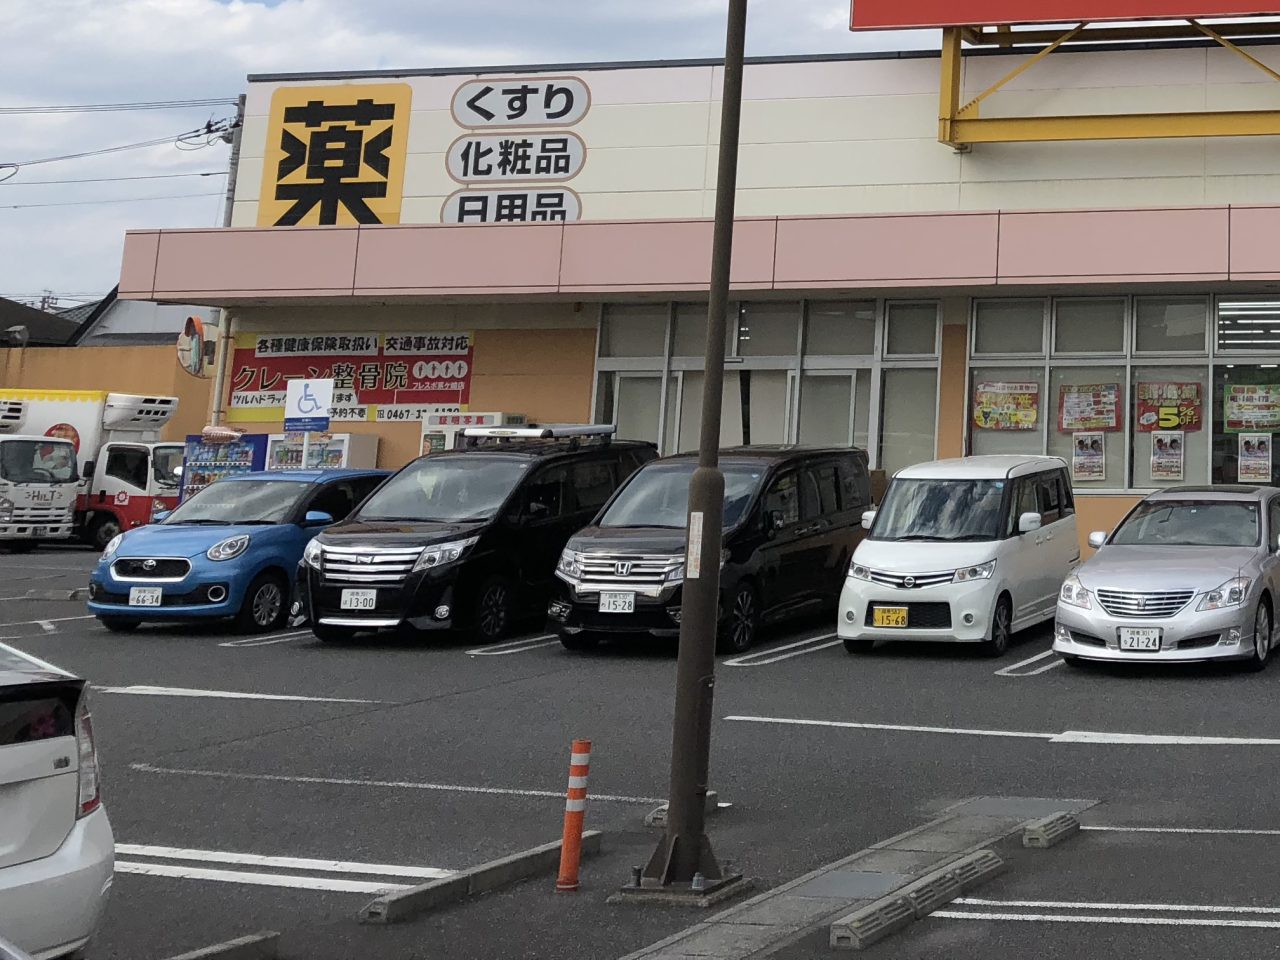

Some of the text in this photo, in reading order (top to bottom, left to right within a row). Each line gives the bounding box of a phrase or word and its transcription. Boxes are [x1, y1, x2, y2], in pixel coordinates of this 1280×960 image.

[465, 83, 574, 121] くすり
[273, 98, 396, 226] 薬
[460, 137, 571, 177] 化粧品
[457, 191, 568, 223] 日用品
[257, 335, 470, 353] 各種健康保険取扱い 交通事故対応
[1179, 415, 1199, 425] OFF
[136, 594, 160, 605] 66-34
[349, 597, 374, 608] 13-00
[607, 600, 633, 611] 15-28
[881, 615, 906, 625] 15-68
[1129, 636, 1157, 648] 21-24
